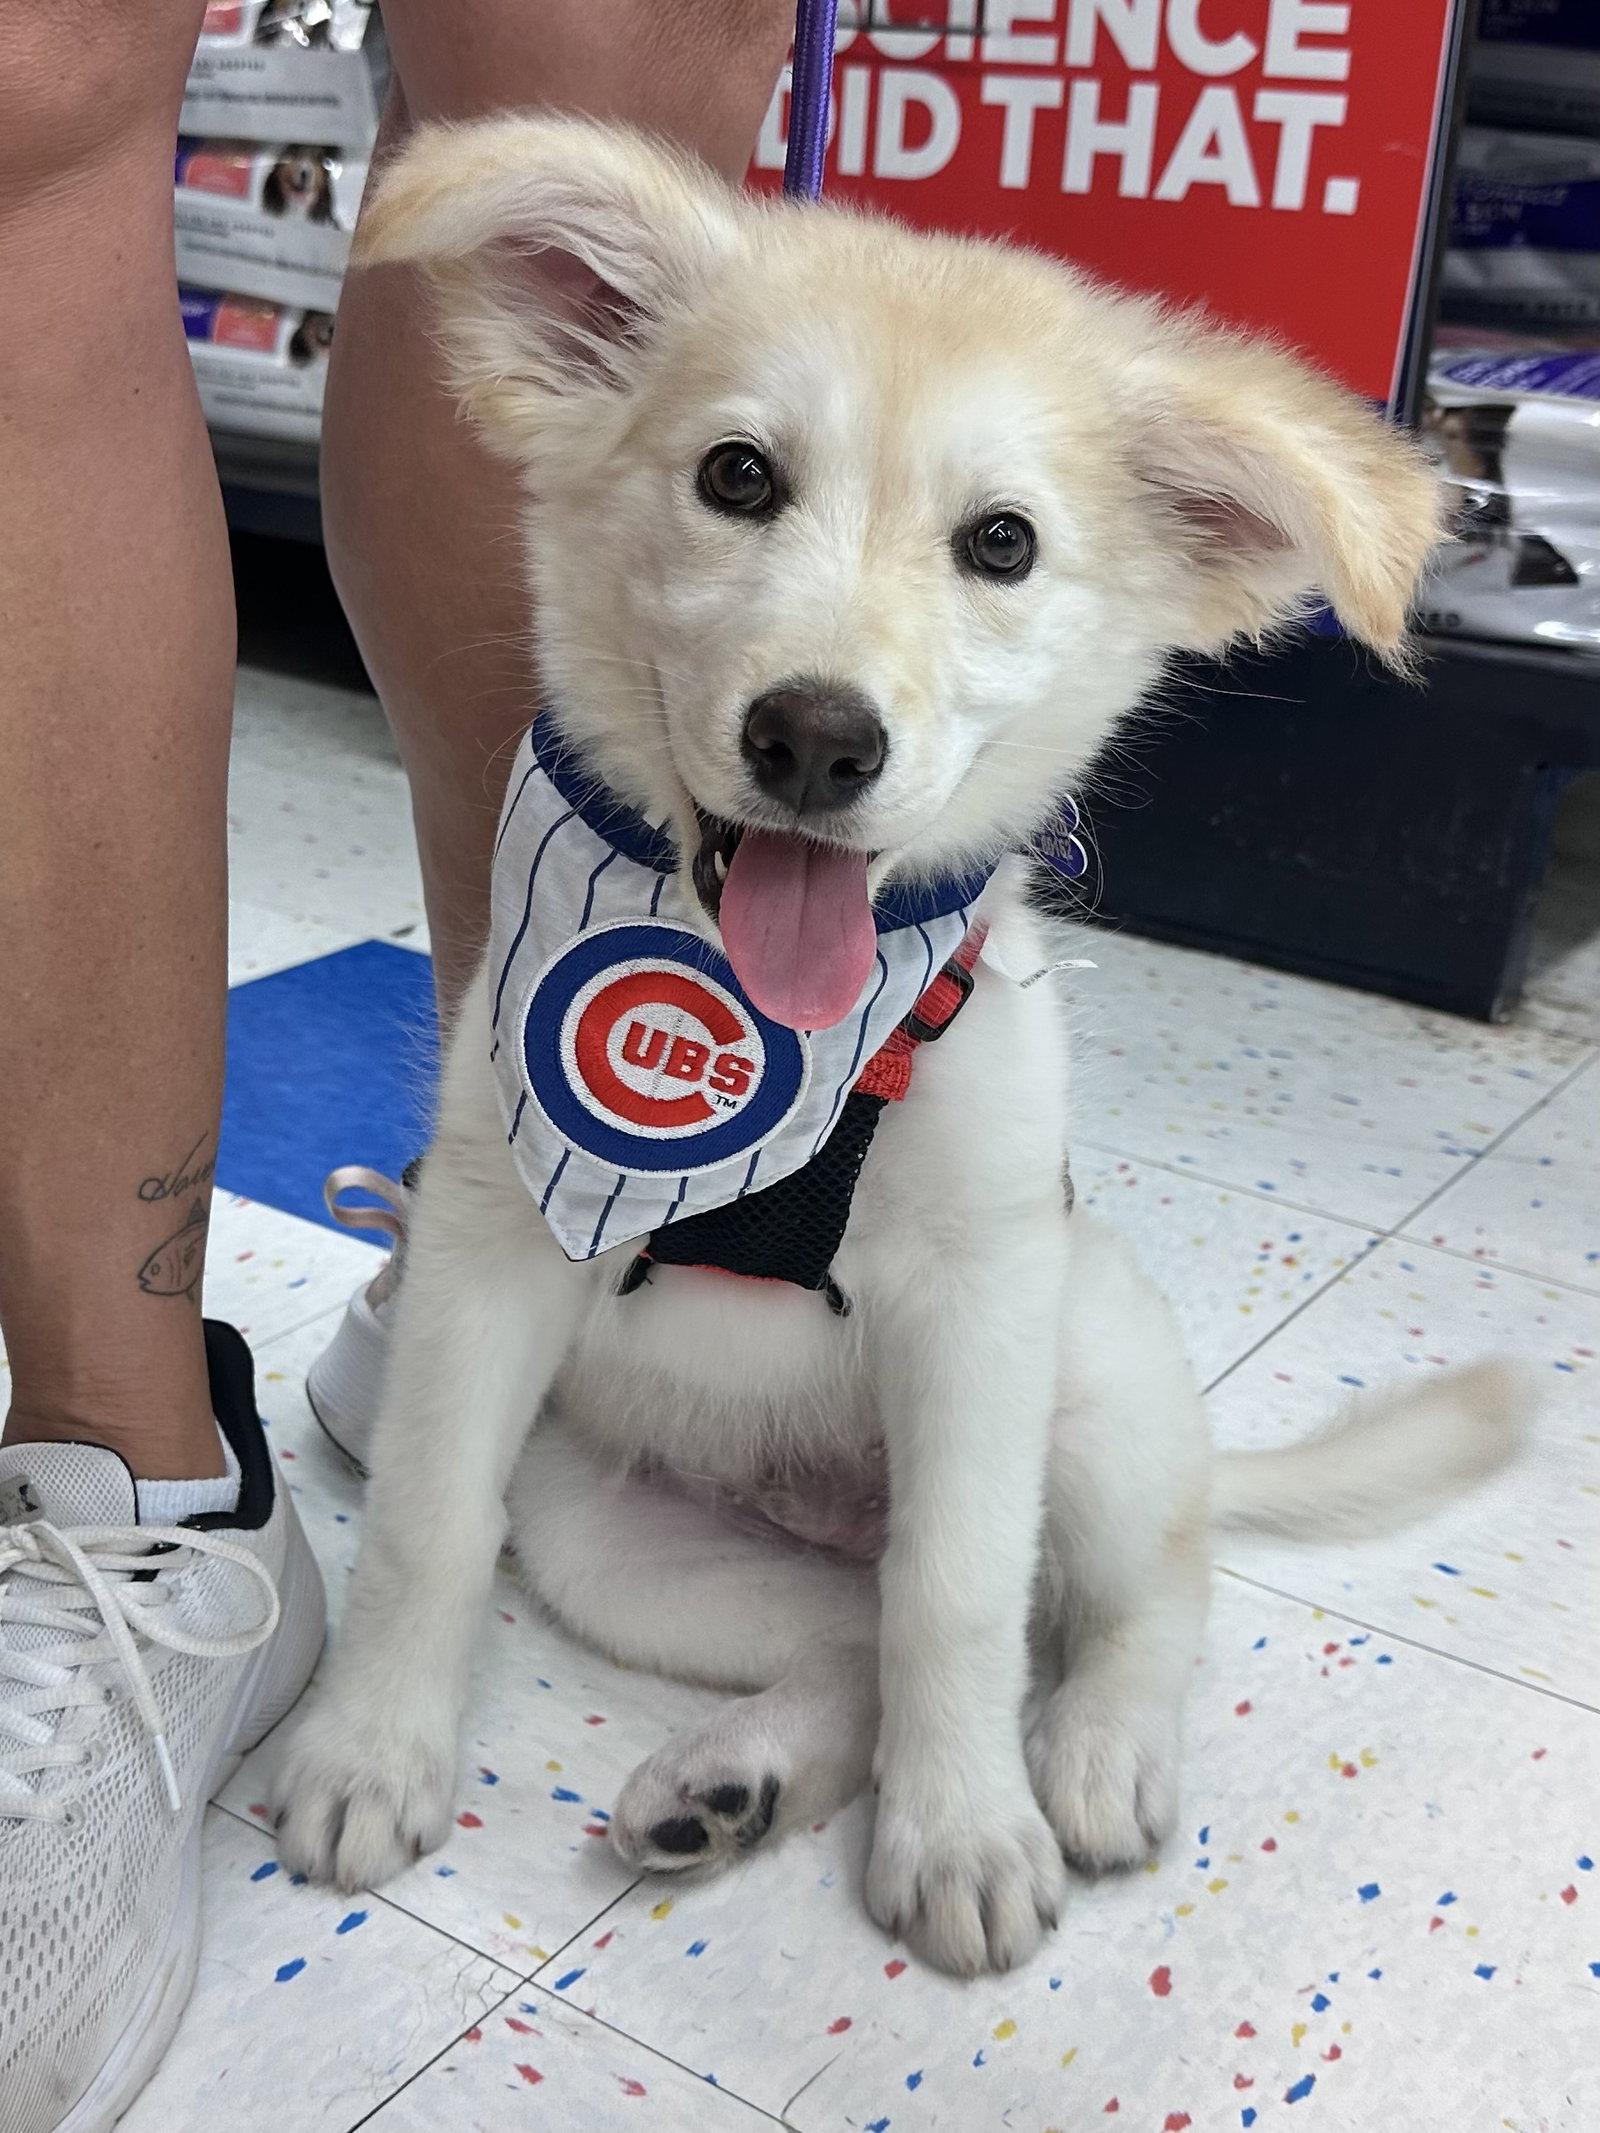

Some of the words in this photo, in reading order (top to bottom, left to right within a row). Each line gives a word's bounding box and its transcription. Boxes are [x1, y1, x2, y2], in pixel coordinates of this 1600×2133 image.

[833, 0, 1352, 81] CIENCE
[980, 75, 1359, 215] THAT.
[714, 1094, 737, 1110] TM
